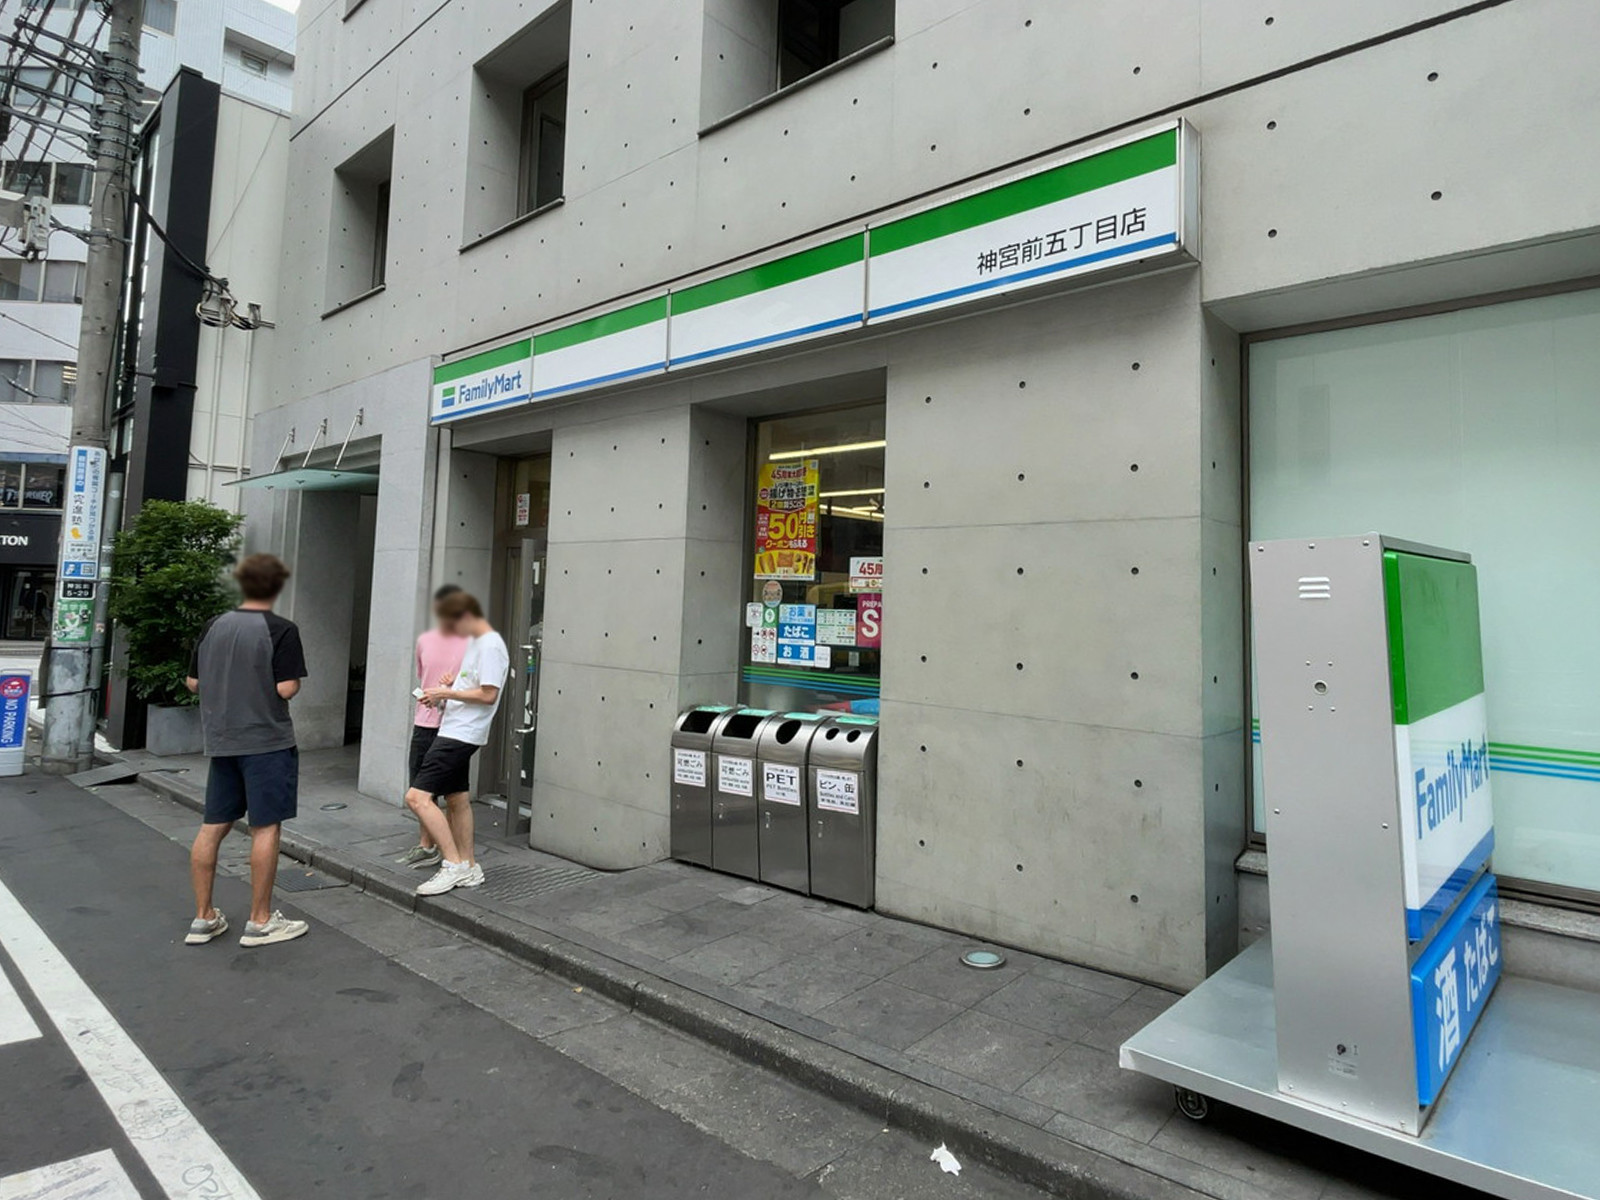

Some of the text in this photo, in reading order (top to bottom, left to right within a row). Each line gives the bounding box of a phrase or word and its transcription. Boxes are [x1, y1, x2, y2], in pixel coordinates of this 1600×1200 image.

[977, 207, 1147, 275] 神宮前五丁目店
[458, 371, 522, 404] FamilyMart
[0, 535, 28, 546] TON
[783, 625, 810, 638] たばこ
[1, 711, 17, 743] PARKING
[765, 772, 797, 786] PET
[819, 780, 855, 794] ビン、缶
[1414, 733, 1490, 840] FamilyMart
[1435, 902, 1498, 1073] 酒 たばこ
